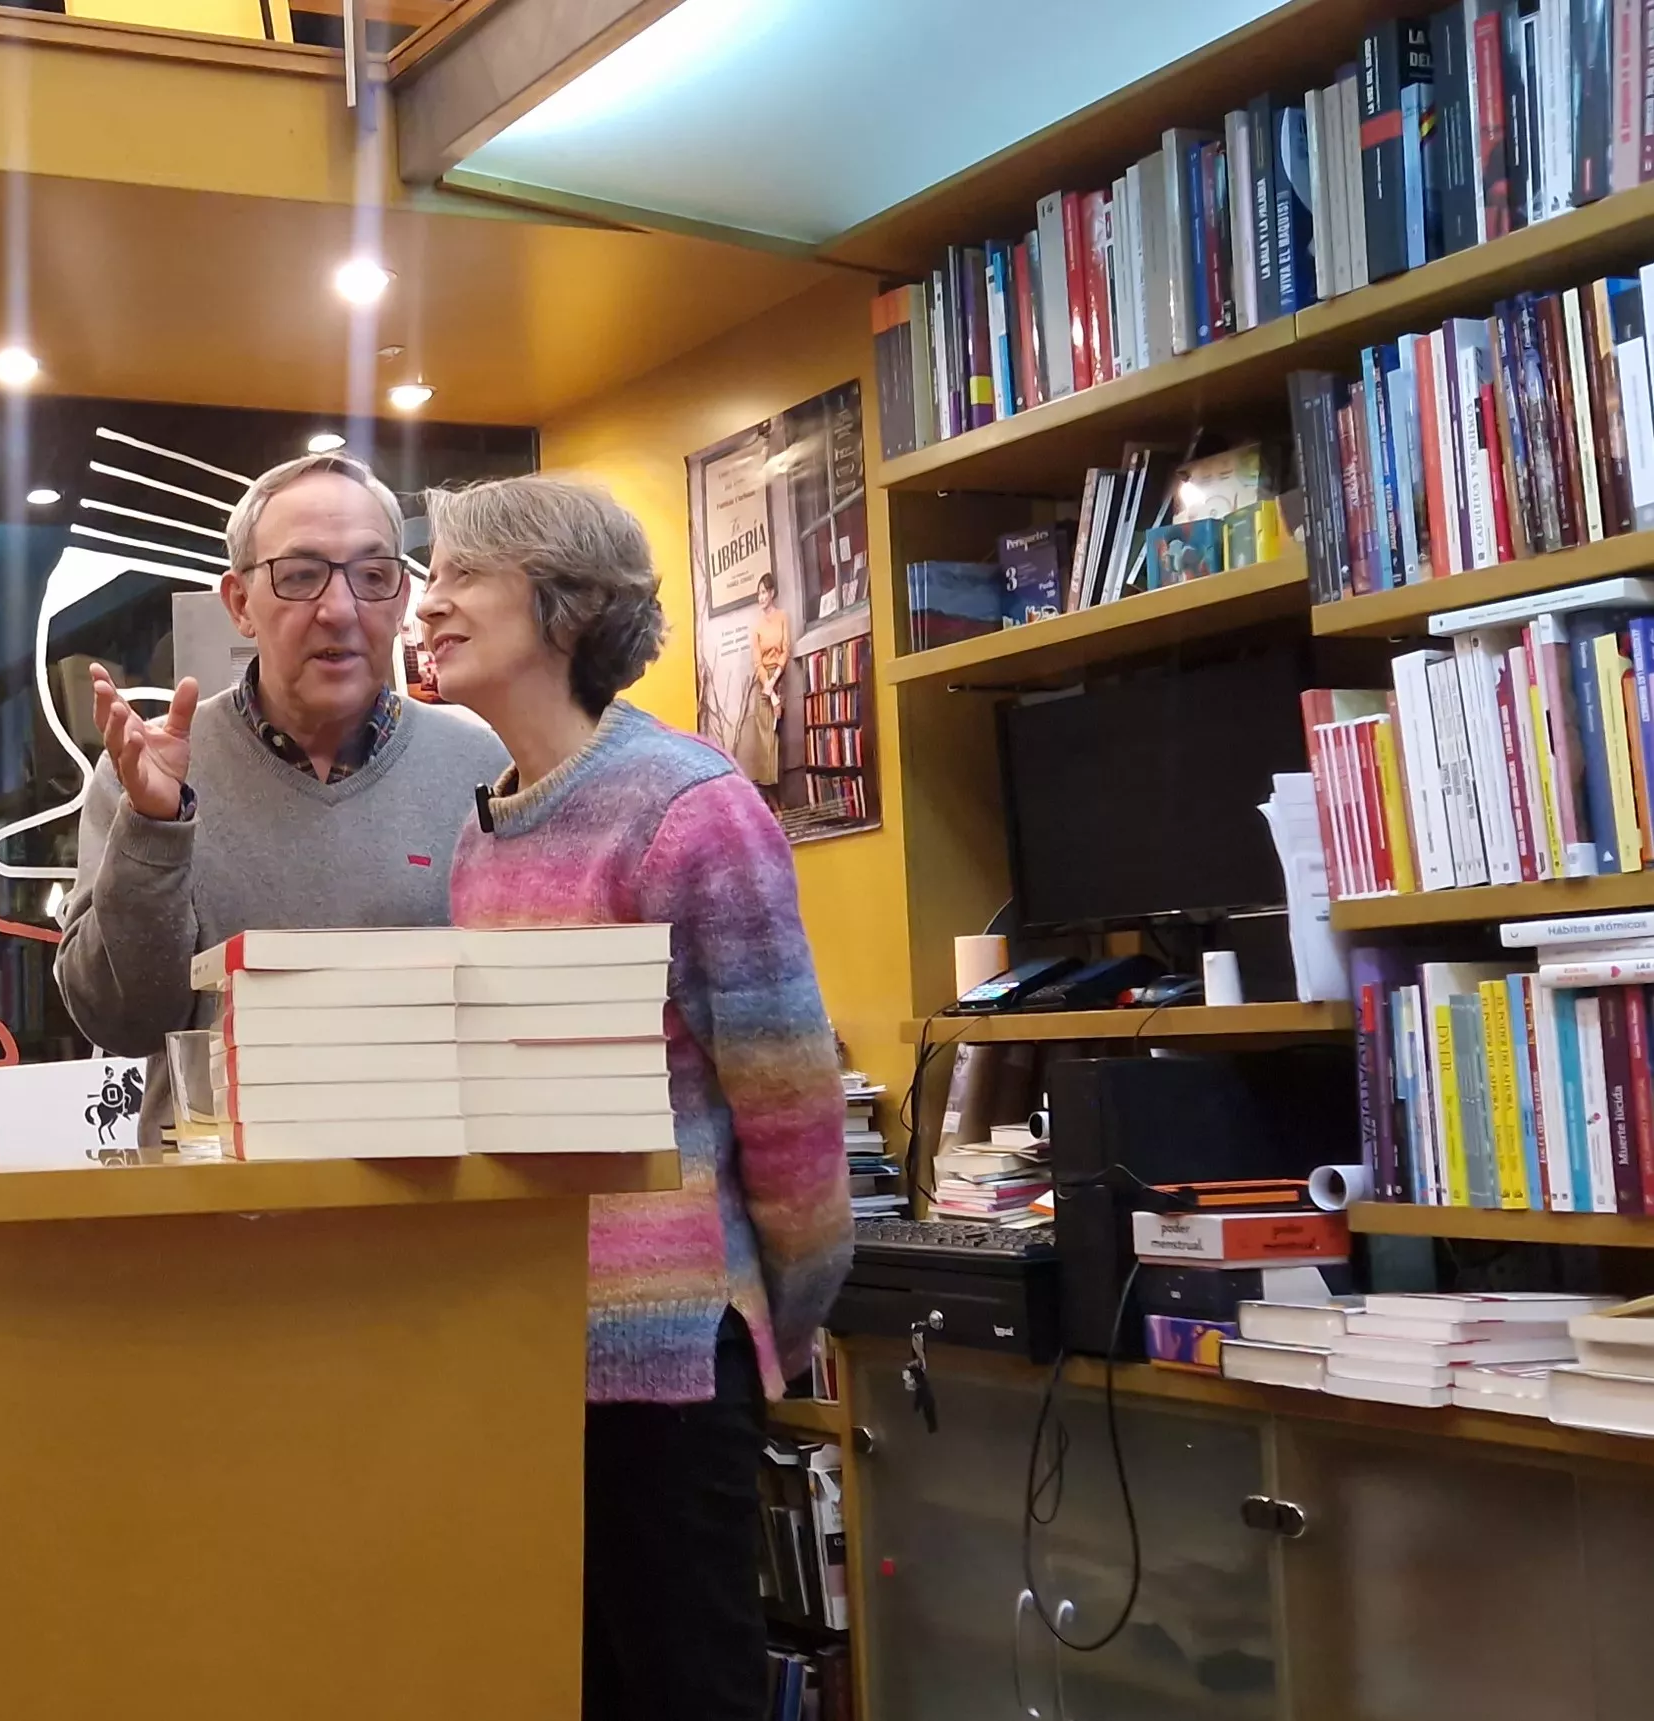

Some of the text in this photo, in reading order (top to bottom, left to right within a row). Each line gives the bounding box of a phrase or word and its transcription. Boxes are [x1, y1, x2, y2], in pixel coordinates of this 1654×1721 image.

[1258, 219, 1268, 232] LA
[1260, 242, 1270, 265] BALA
[1279, 249, 1290, 264] EL
[1260, 266, 1271, 280] LA
[711, 519, 767, 578] LIBRERÍA
[1005, 566, 1018, 592] 3
[1547, 920, 1647, 936] Hábitos atómicos
[1436, 1025, 1452, 1073] DYER
[1496, 1011, 1508, 1046] PODER
[1504, 1074, 1514, 1111] AHORA
[1612, 1085, 1629, 1165] Muerte lúcida
[1160, 1221, 1190, 1237] poder
